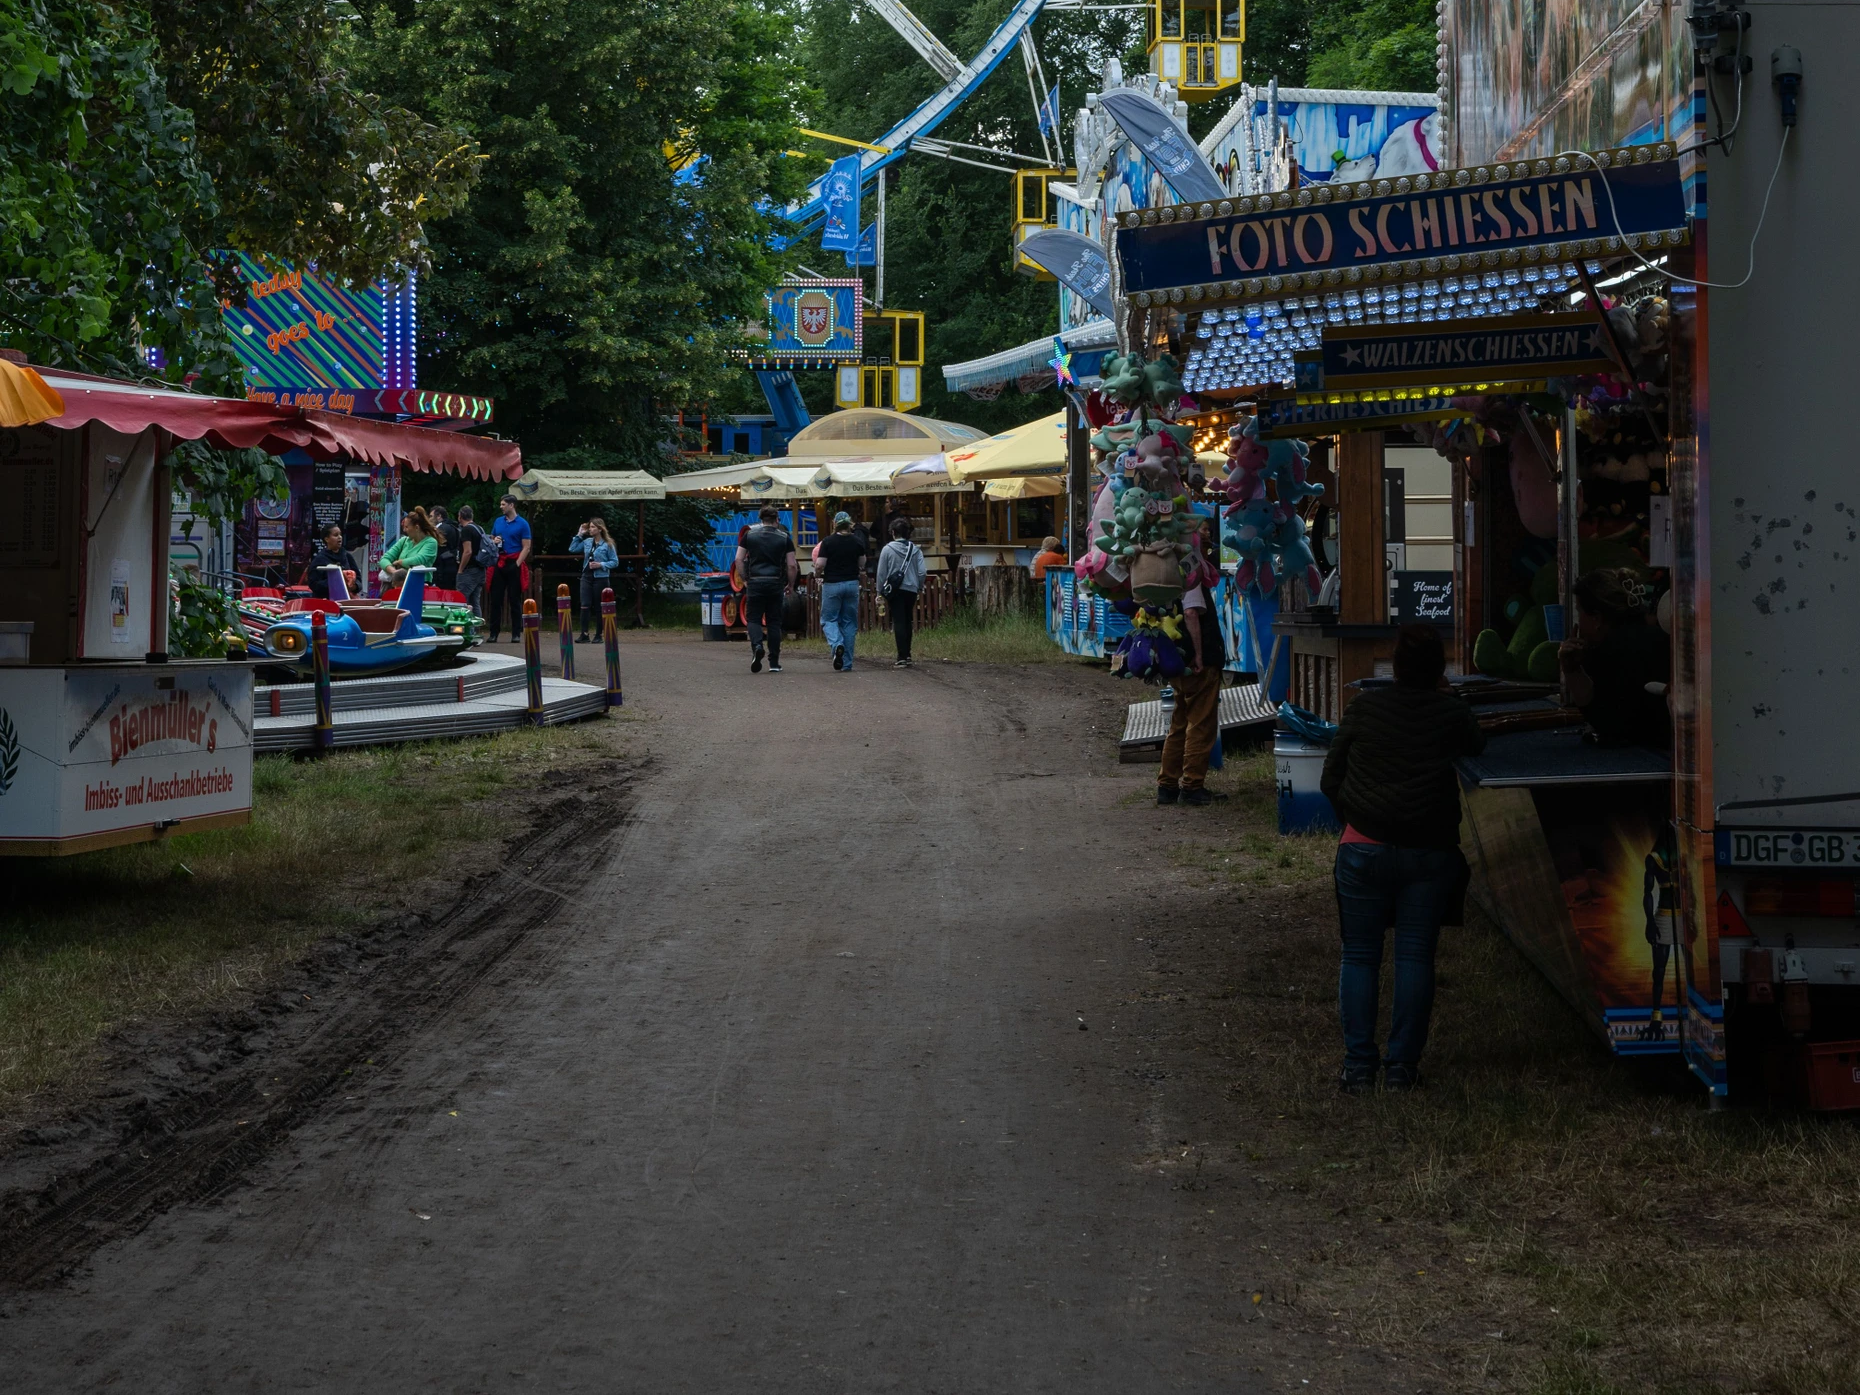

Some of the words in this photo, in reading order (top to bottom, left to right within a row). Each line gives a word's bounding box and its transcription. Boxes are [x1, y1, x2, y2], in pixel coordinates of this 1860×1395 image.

[1206, 212, 1334, 276] FOTO
[1348, 177, 1598, 258] SCHIESSEN
[266, 320, 311, 356] goes
[313, 309, 337, 333] to
[1362, 330, 1580, 369] WALZENSCHIESSEN
[246, 385, 277, 406] Have
[280, 391, 294, 407] a
[296, 387, 326, 410] nice
[328, 388, 356, 414] day
[608, 489, 623, 497] Apfel
[865, 483, 883, 492] Beste
[1413, 581, 1440, 592] Home
[1442, 581, 1452, 595] of
[1420, 593, 1448, 606] finest
[1415, 605, 1452, 619] Seafood
[341, 631, 349, 641] 2
[85, 780, 123, 811] Imbiss-
[125, 776, 145, 806] und
[146, 766, 234, 804] Ausschankbetriebe
[1734, 833, 1790, 862] DGF
[1808, 834, 1845, 863] GB
